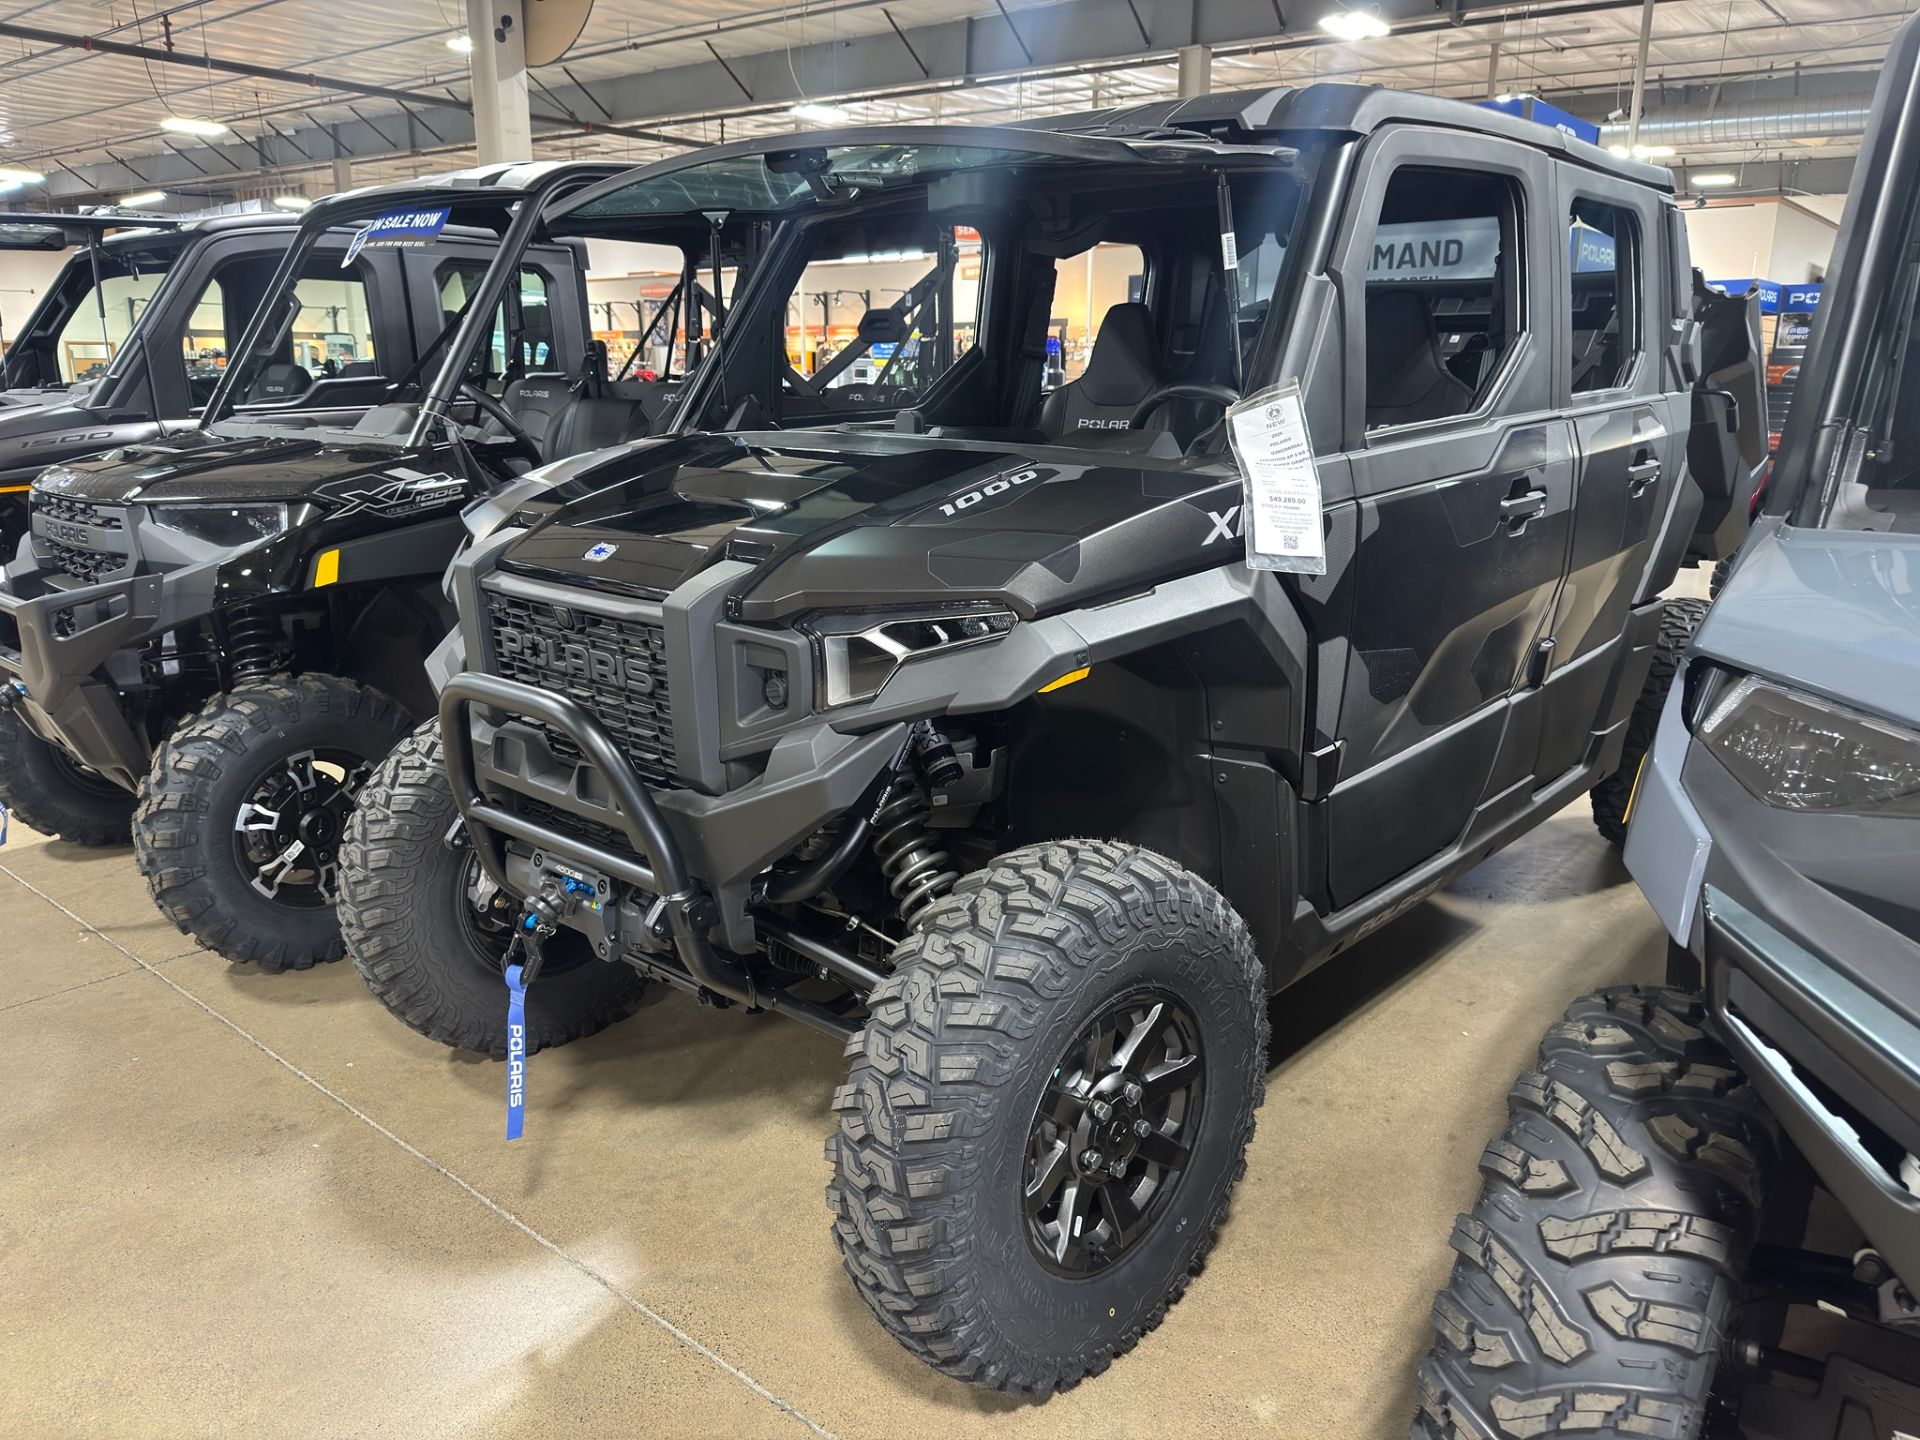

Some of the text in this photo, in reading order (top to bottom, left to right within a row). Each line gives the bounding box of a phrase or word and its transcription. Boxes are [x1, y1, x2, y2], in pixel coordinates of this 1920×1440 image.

[382, 215, 414, 229] SALE
[410, 212, 442, 227] NOW
[1366, 239, 1463, 271] MAND
[519, 389, 549, 398] POLARIS
[1266, 418, 1285, 429] NEW
[1270, 437, 1291, 447] POLARIS
[415, 486, 462, 502] 1000
[939, 470, 1037, 516] 1000
[45, 520, 89, 545] POLARIS
[1201, 504, 1244, 546] X
[501, 627, 655, 693] POLARIS
[555, 864, 575, 877] 4500
[510, 1024, 523, 1108] POLARIS
